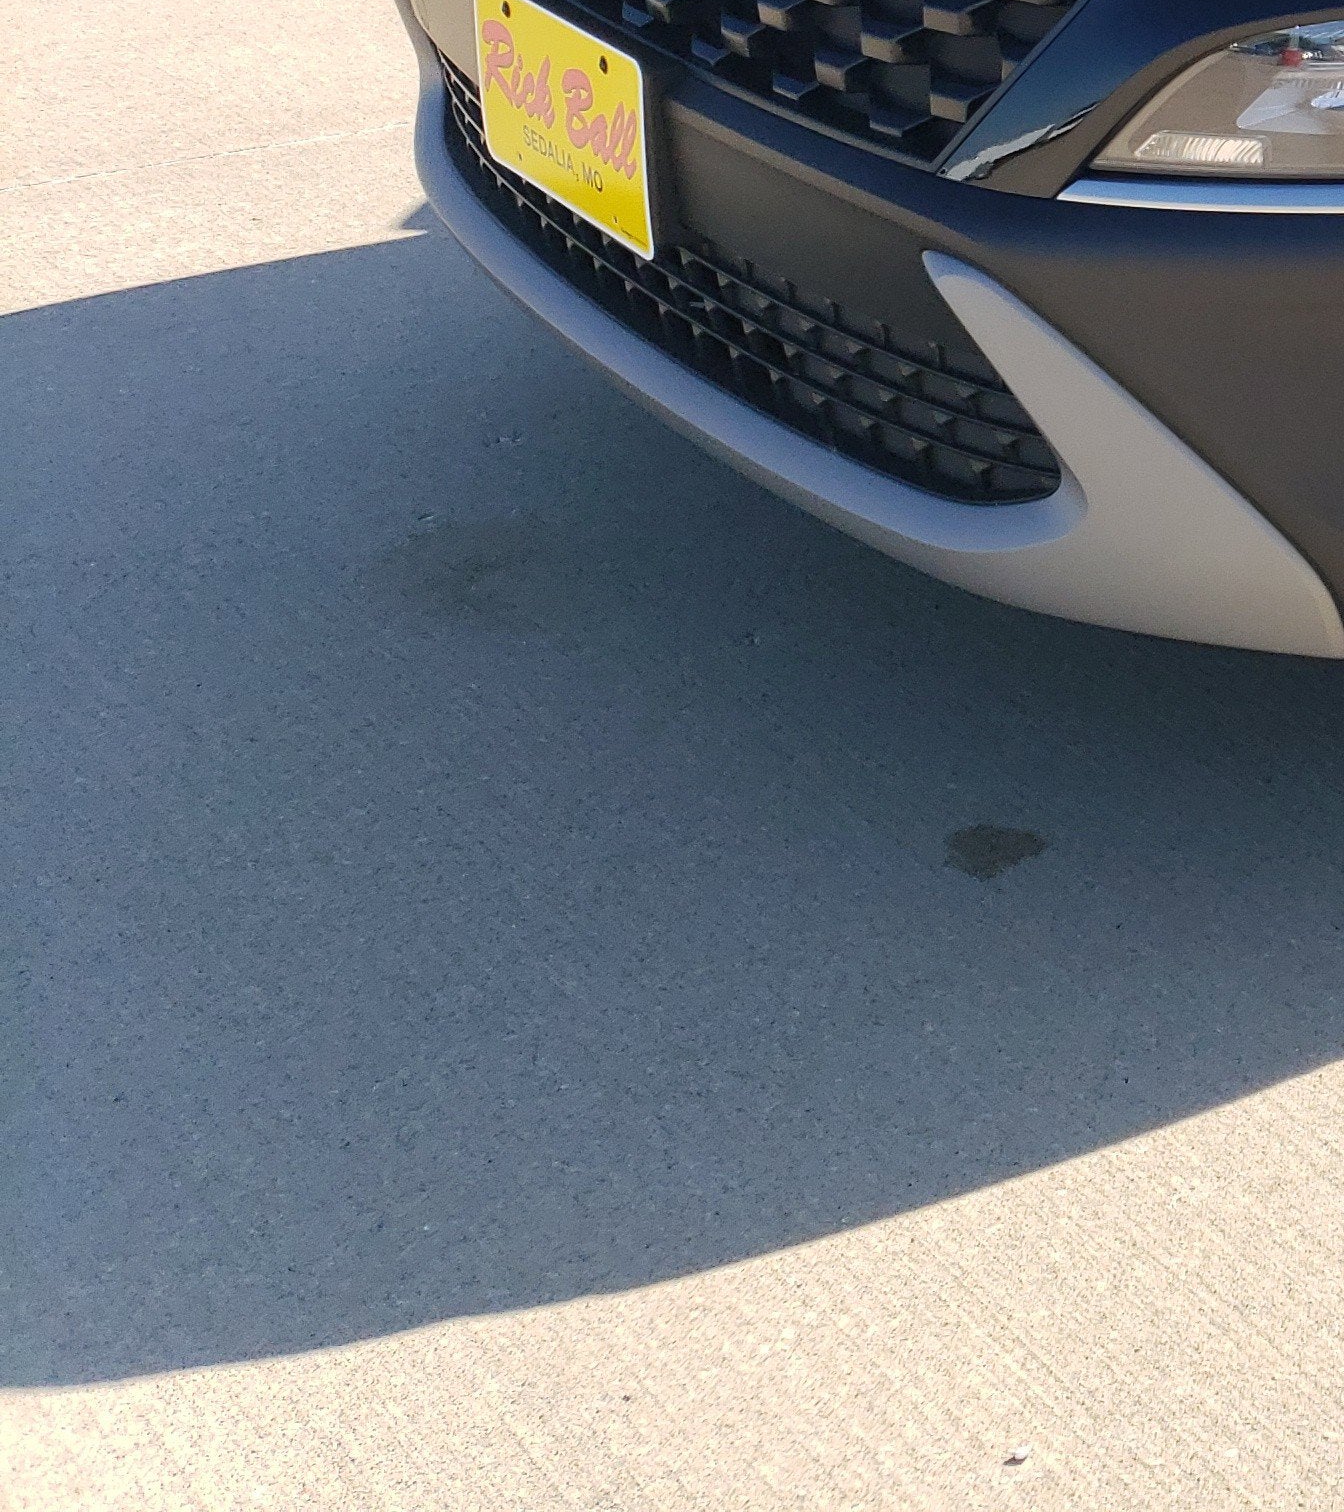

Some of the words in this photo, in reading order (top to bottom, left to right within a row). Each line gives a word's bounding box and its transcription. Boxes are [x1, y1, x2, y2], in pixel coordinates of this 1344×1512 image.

[482, 20, 555, 129] Rich
[562, 69, 637, 180] Ball
[523, 125, 580, 182] SEDALIA,
[581, 162, 604, 192] MO
